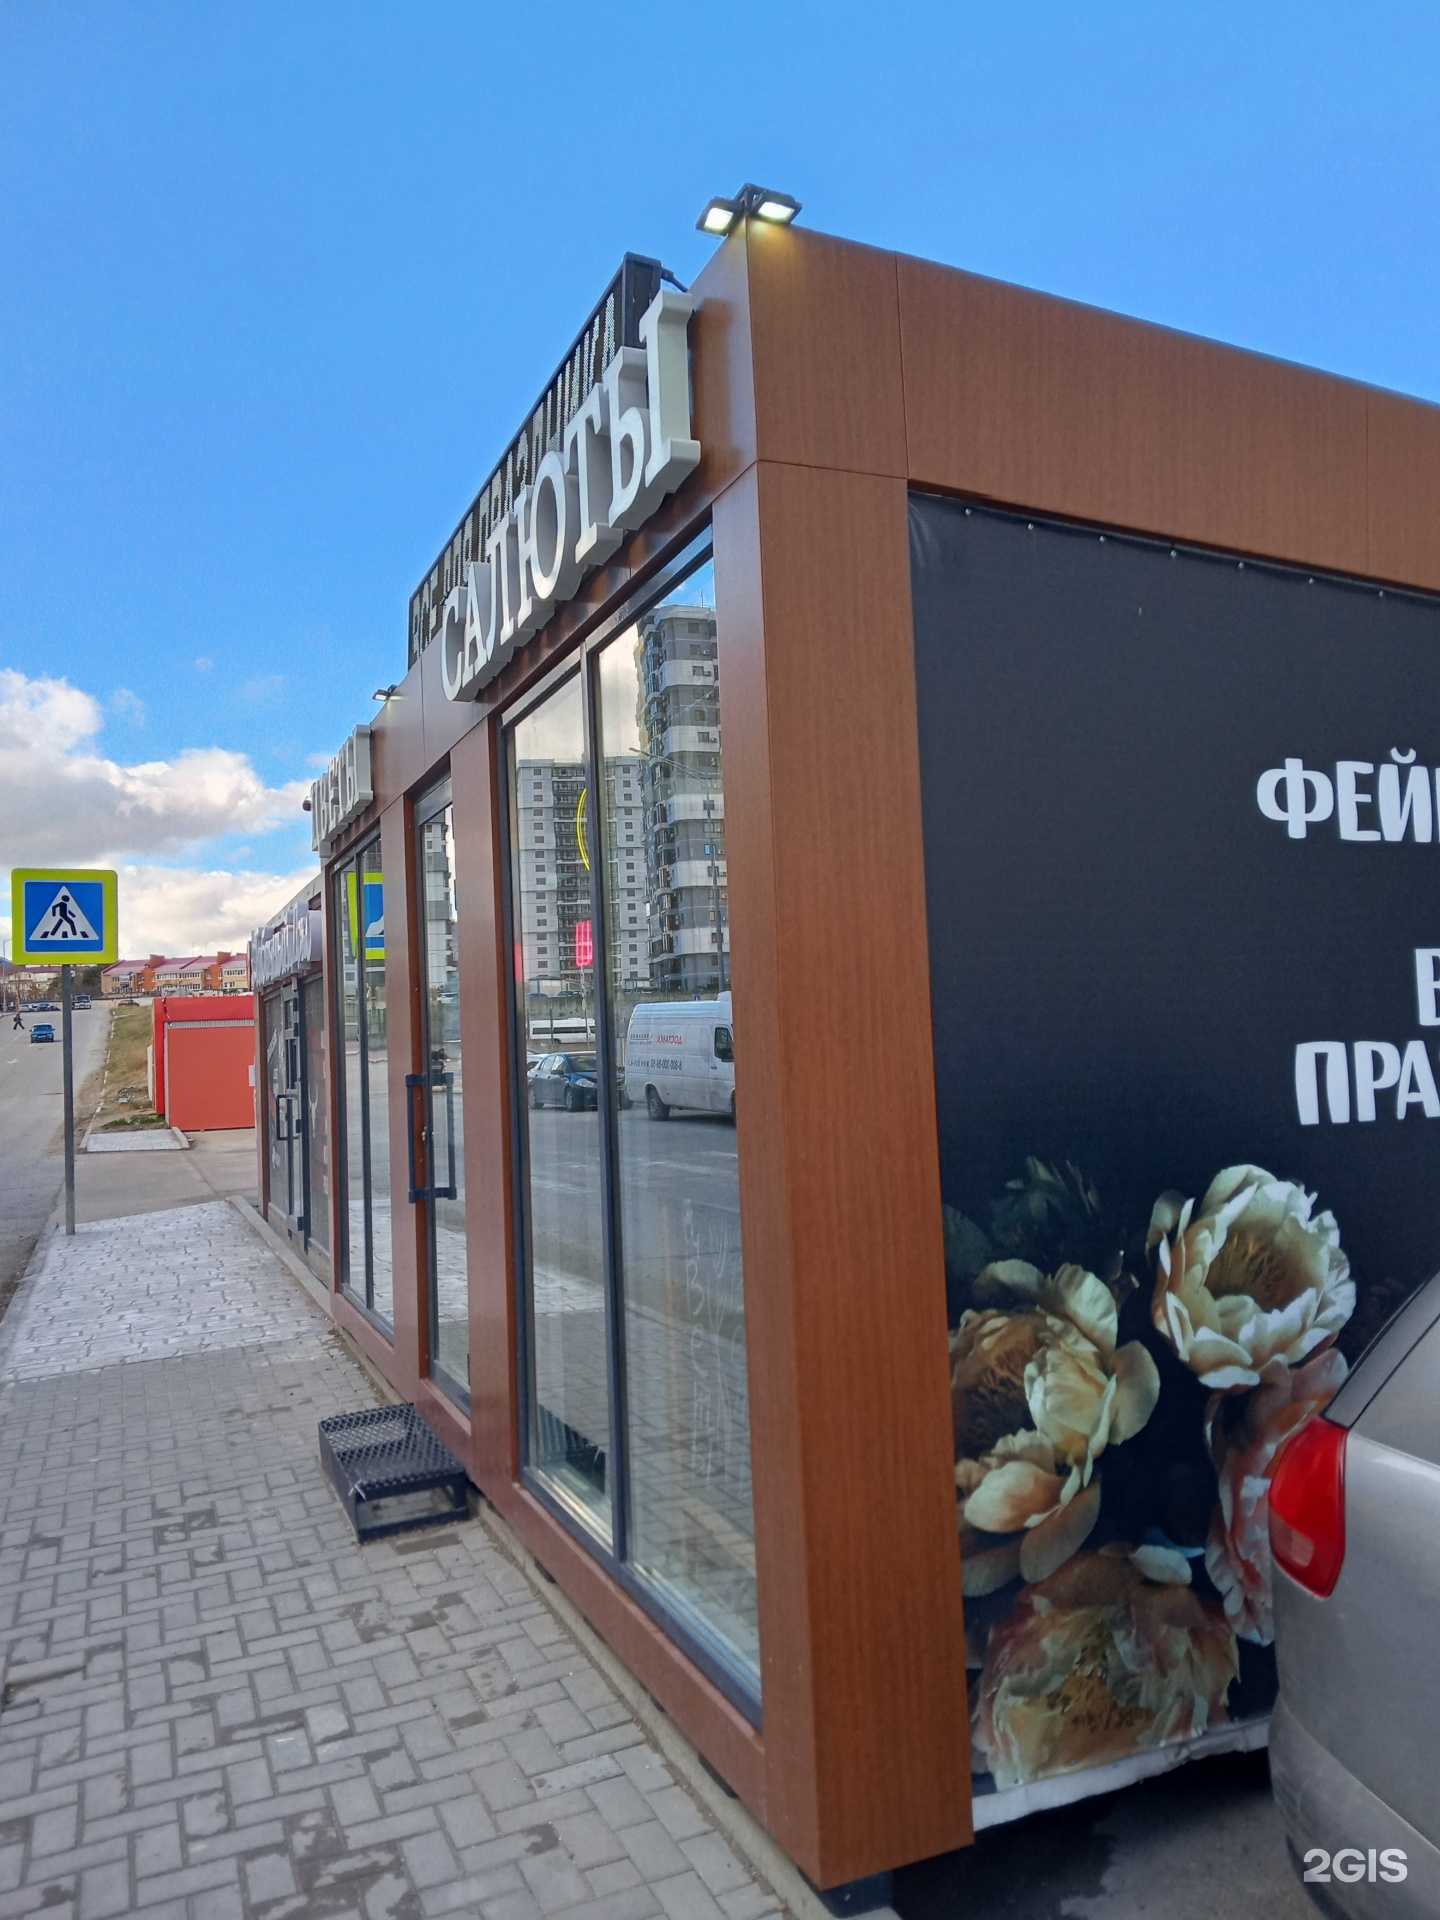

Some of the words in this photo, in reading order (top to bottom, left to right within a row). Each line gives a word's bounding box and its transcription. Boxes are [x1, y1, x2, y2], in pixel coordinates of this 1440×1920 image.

[440, 290, 701, 702] САЛЮТЫ
[311, 724, 374, 856] ЦВЕТЫ
[1256, 746, 1440, 844] ФЕЙ
[1294, 1040, 1440, 1126] ПРА
